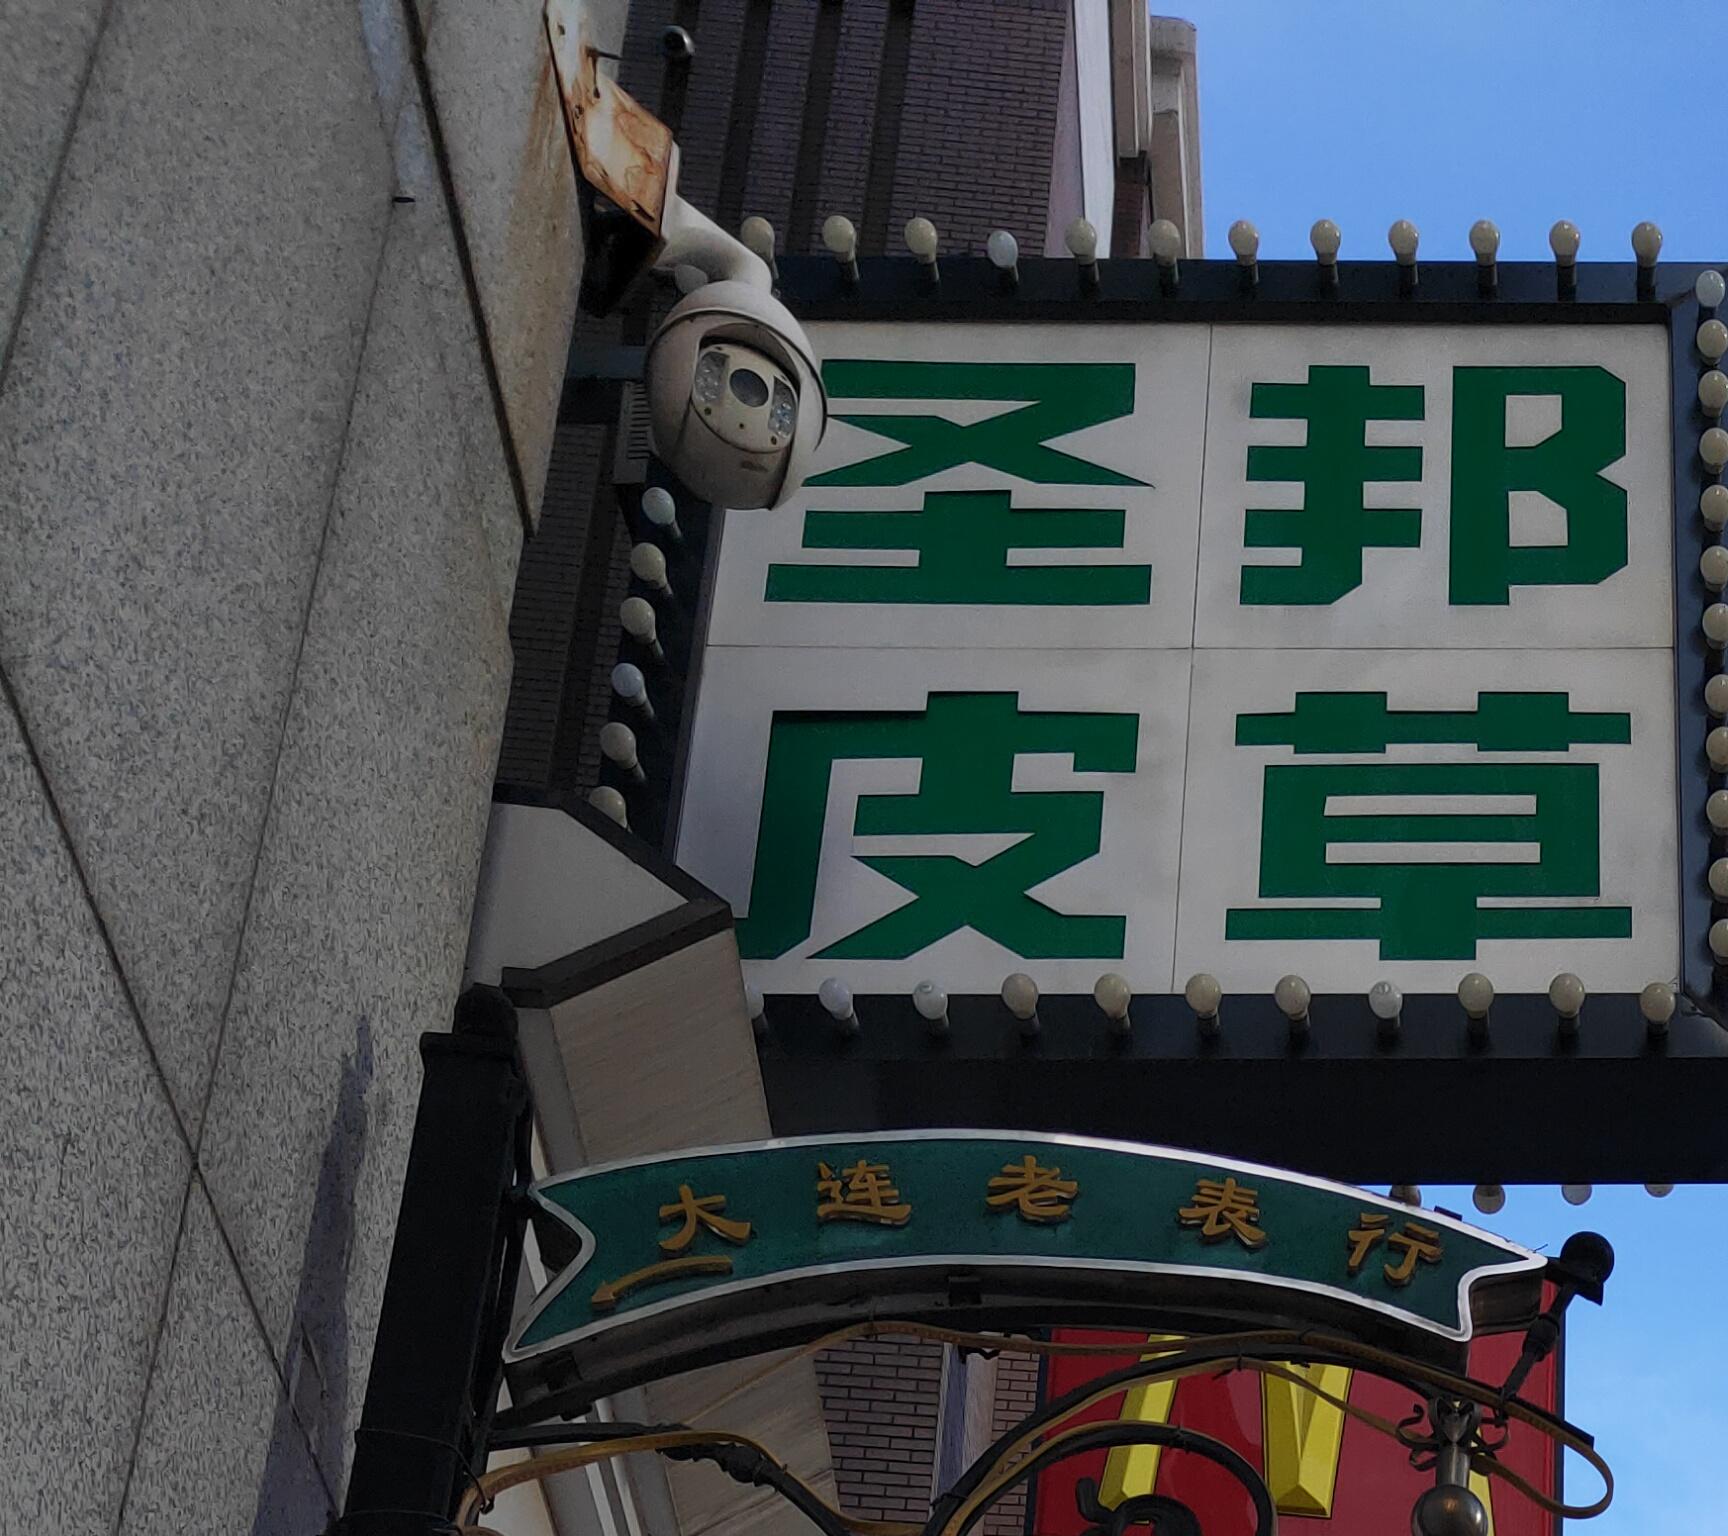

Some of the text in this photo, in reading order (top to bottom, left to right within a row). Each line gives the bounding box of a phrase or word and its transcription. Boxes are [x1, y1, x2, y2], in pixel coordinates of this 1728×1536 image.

[764, 357, 1629, 607] 圣邦
[732, 690, 1634, 963] 皮草
[655, 1152, 1444, 1288] 大连老表行
